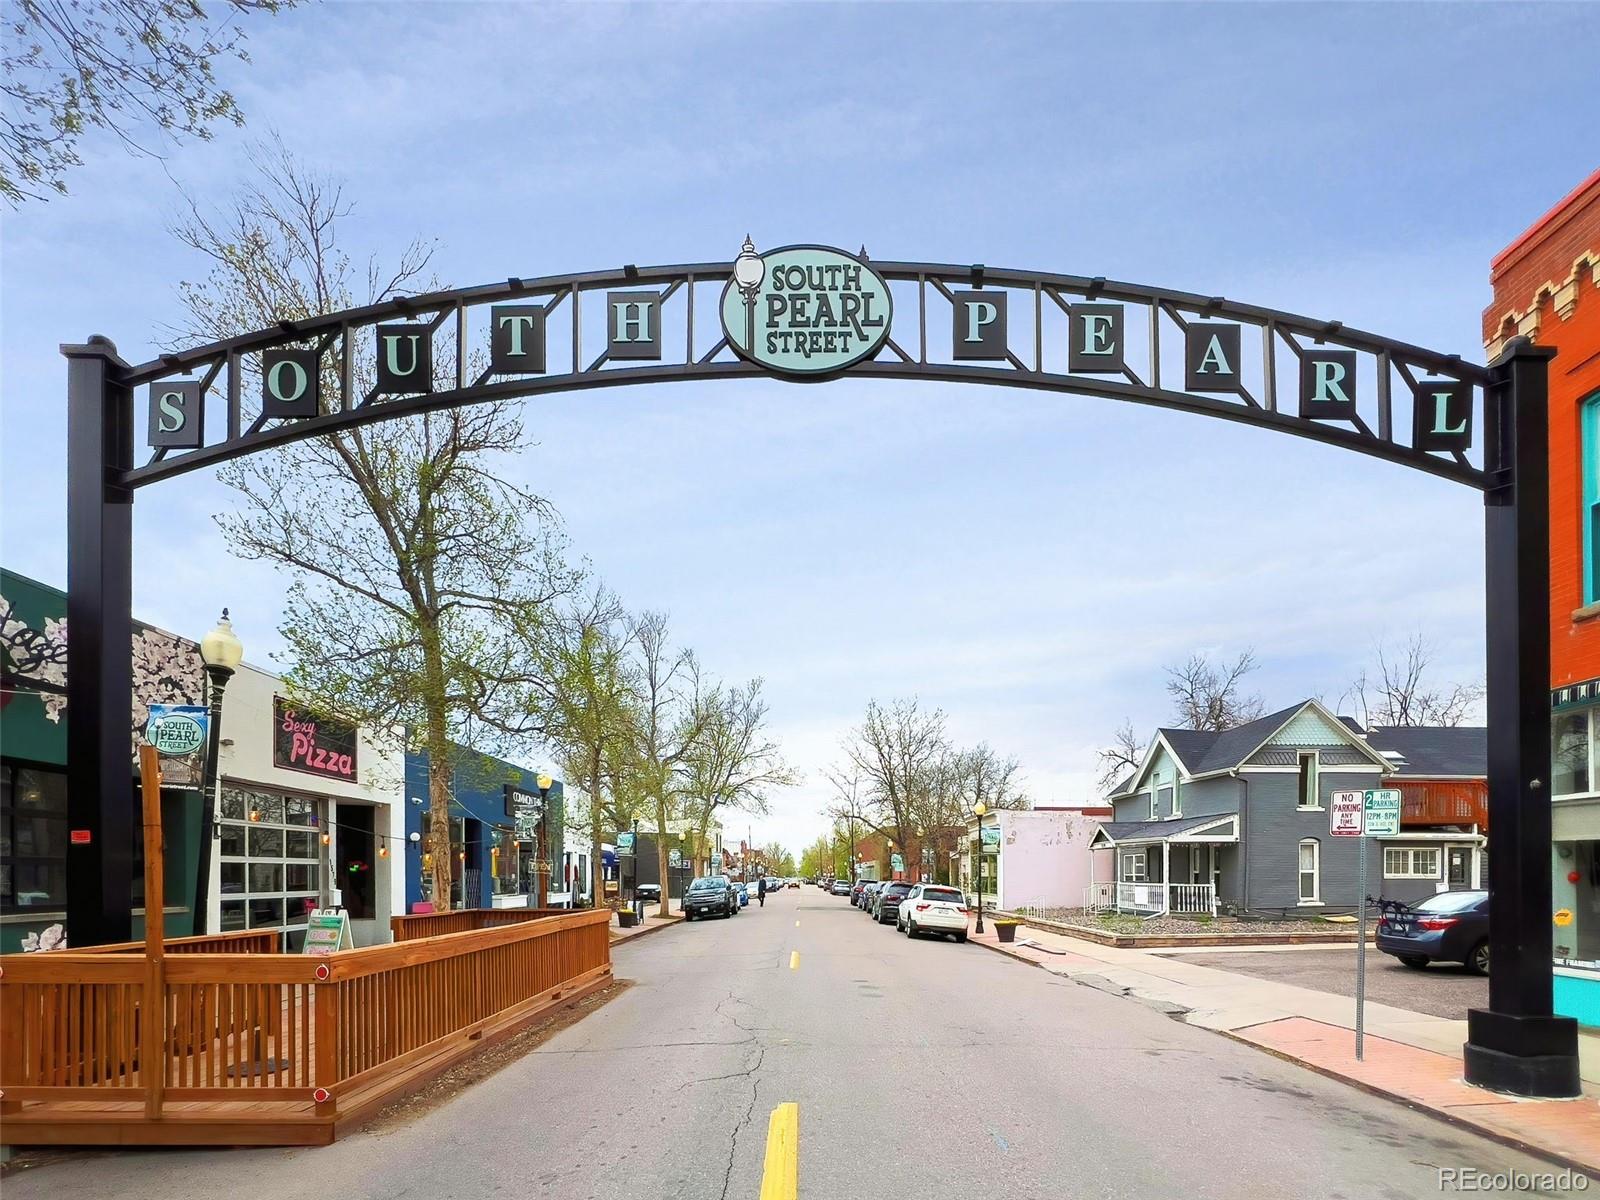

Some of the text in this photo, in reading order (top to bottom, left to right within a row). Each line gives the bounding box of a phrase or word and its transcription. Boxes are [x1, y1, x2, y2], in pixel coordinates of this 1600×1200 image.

[772, 264, 861, 291] SOUTH
[766, 292, 883, 341] PEARL
[766, 331, 852, 358] STREET
[157, 301, 1467, 435] SOUTH PEARL
[163, 721, 193, 730] SOUTH
[282, 710, 315, 739] Sexy
[159, 741, 188, 749] STREET
[160, 730, 199, 745] PEARL
[291, 733, 352, 775] Pizza
[1333, 804, 1361, 812] PARKING
[1341, 793, 1354, 802] NO
[1365, 793, 1372, 807] 2
